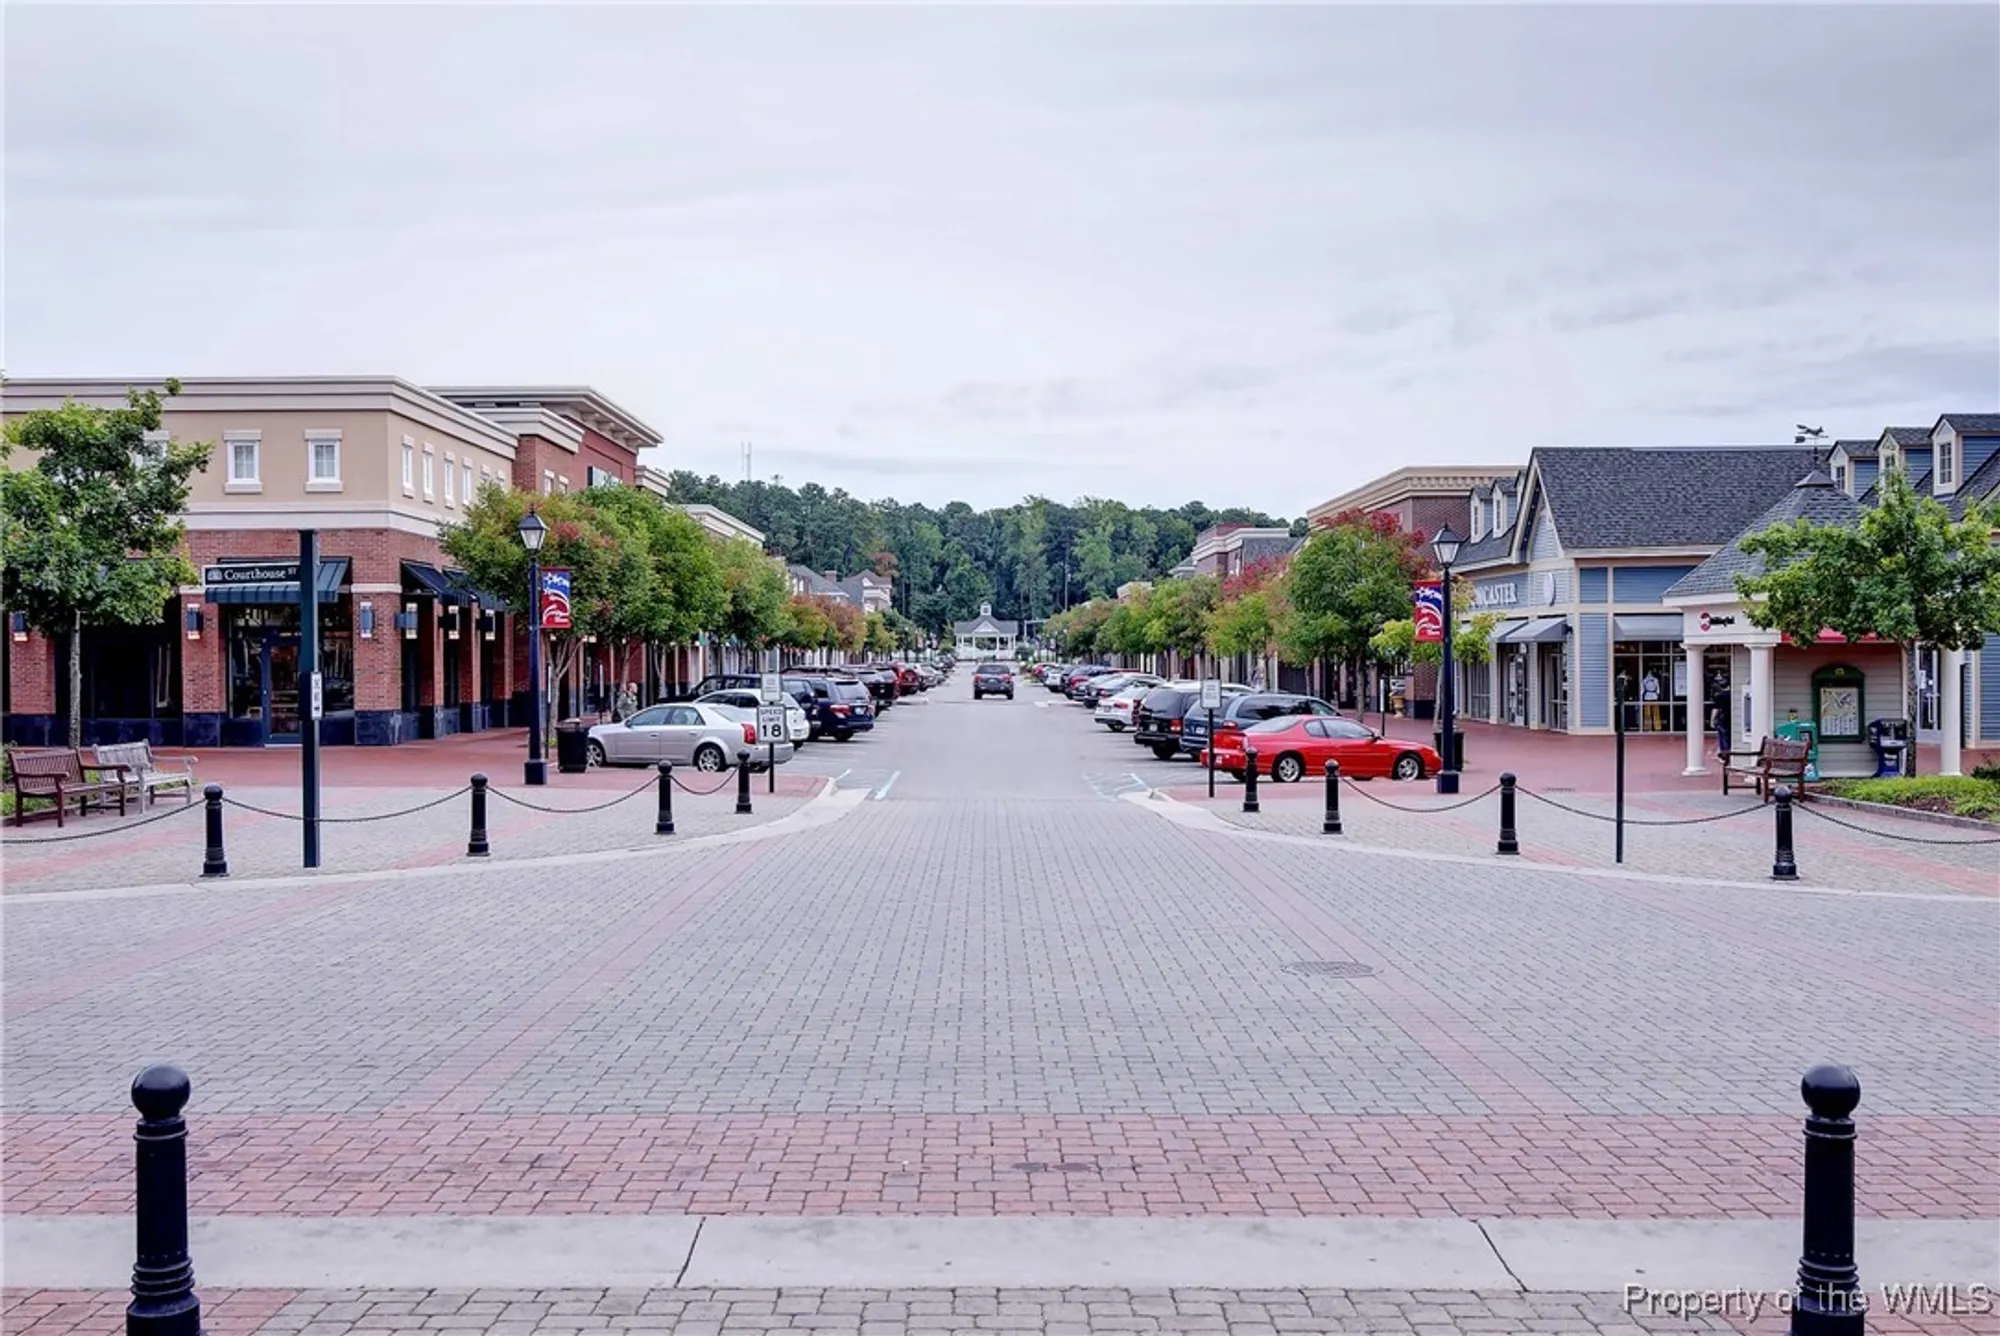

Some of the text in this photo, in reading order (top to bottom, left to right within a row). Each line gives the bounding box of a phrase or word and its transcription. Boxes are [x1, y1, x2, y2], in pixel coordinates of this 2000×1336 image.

[224, 567, 298, 580] Courthouse ST
[762, 724, 782, 737] 18
